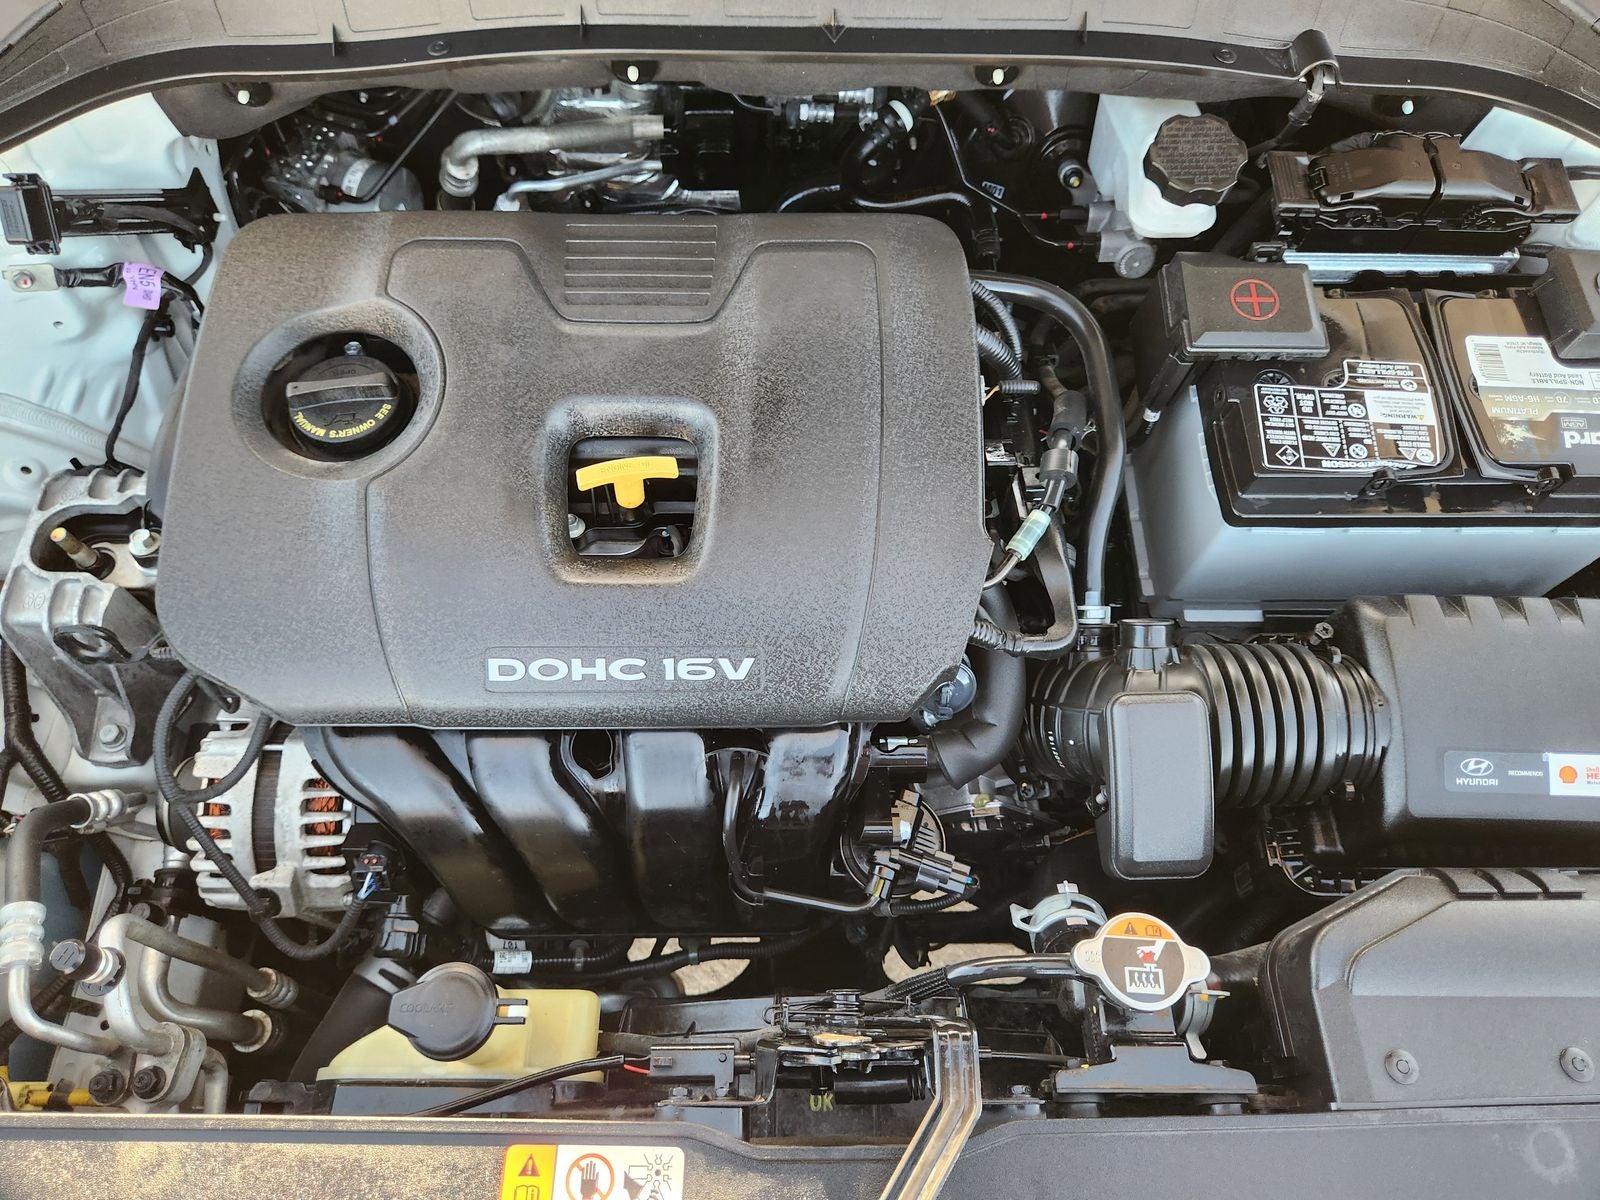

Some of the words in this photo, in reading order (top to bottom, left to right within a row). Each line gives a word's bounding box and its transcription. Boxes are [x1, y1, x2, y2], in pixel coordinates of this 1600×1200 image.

[1503, 394, 1540, 403] H6-AGM
[373, 402, 392, 420] SEE
[1491, 407, 1539, 415] PLATINUM
[293, 411, 327, 437] MANUAL
[328, 418, 376, 439] OWNER'S
[487, 657, 648, 682] DOHC
[662, 657, 757, 681] 16V
[1456, 777, 1499, 786] HYUNDAI
